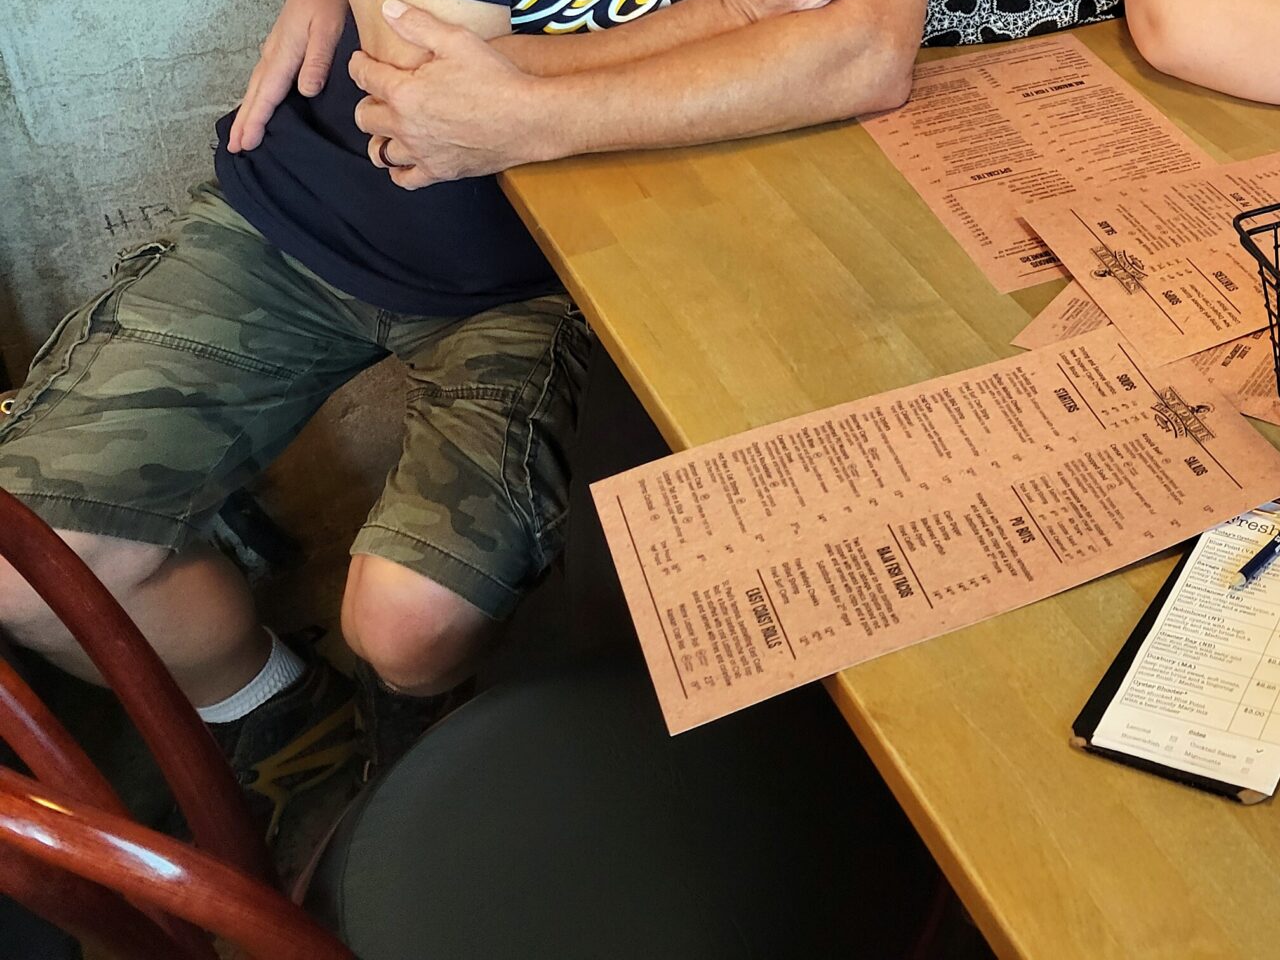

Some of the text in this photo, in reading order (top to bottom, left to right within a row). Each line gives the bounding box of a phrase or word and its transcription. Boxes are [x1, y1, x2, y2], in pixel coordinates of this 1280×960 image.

[970, 167, 1012, 180] SPECIALTIES
[1097, 220, 1117, 235] SALADS
[1212, 270, 1235, 291] STARTERS
[1161, 289, 1182, 305] SOUPS
[1116, 373, 1136, 391] SOUPS
[1053, 387, 1079, 412] STARTERS
[1170, 409, 1203, 444] PAUL
[1183, 456, 1208, 476] SALADS
[1015, 526, 1035, 543] BOYS
[1240, 547, 1255, 555] (VA
[876, 545, 913, 598] BAJA FISH TACOS
[745, 587, 782, 648] EAST COAST ROLLS
[1131, 678, 1156, 690] Oyster
